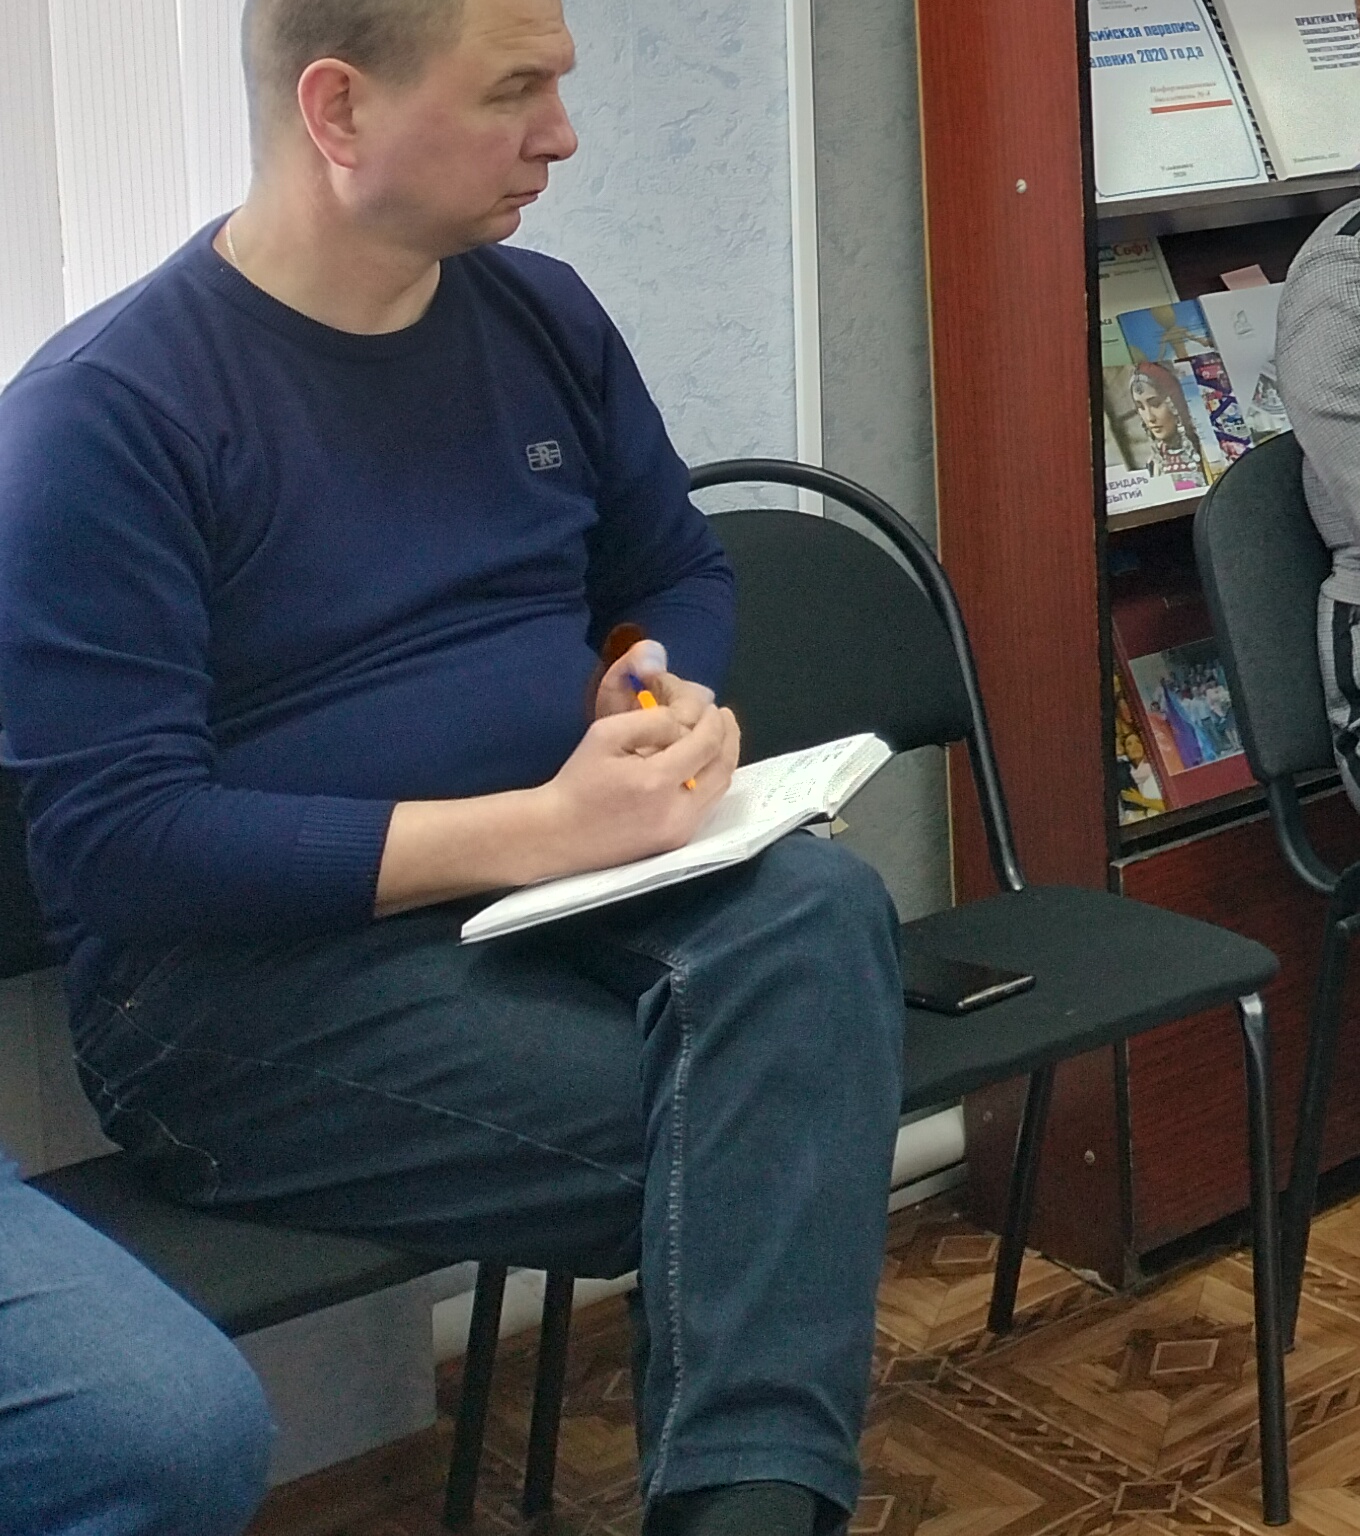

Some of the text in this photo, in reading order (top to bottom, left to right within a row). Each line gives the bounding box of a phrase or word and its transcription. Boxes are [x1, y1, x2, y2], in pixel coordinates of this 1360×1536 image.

[1294, 14, 1336, 26] ПРАКТИКА
[1144, 21, 1201, 37] перепись
[1136, 47, 1168, 63] 2020
[1170, 46, 1205, 61] года
[1113, 244, 1150, 256] Софт
[1106, 477, 1149, 491] ЕНДАРЬ
